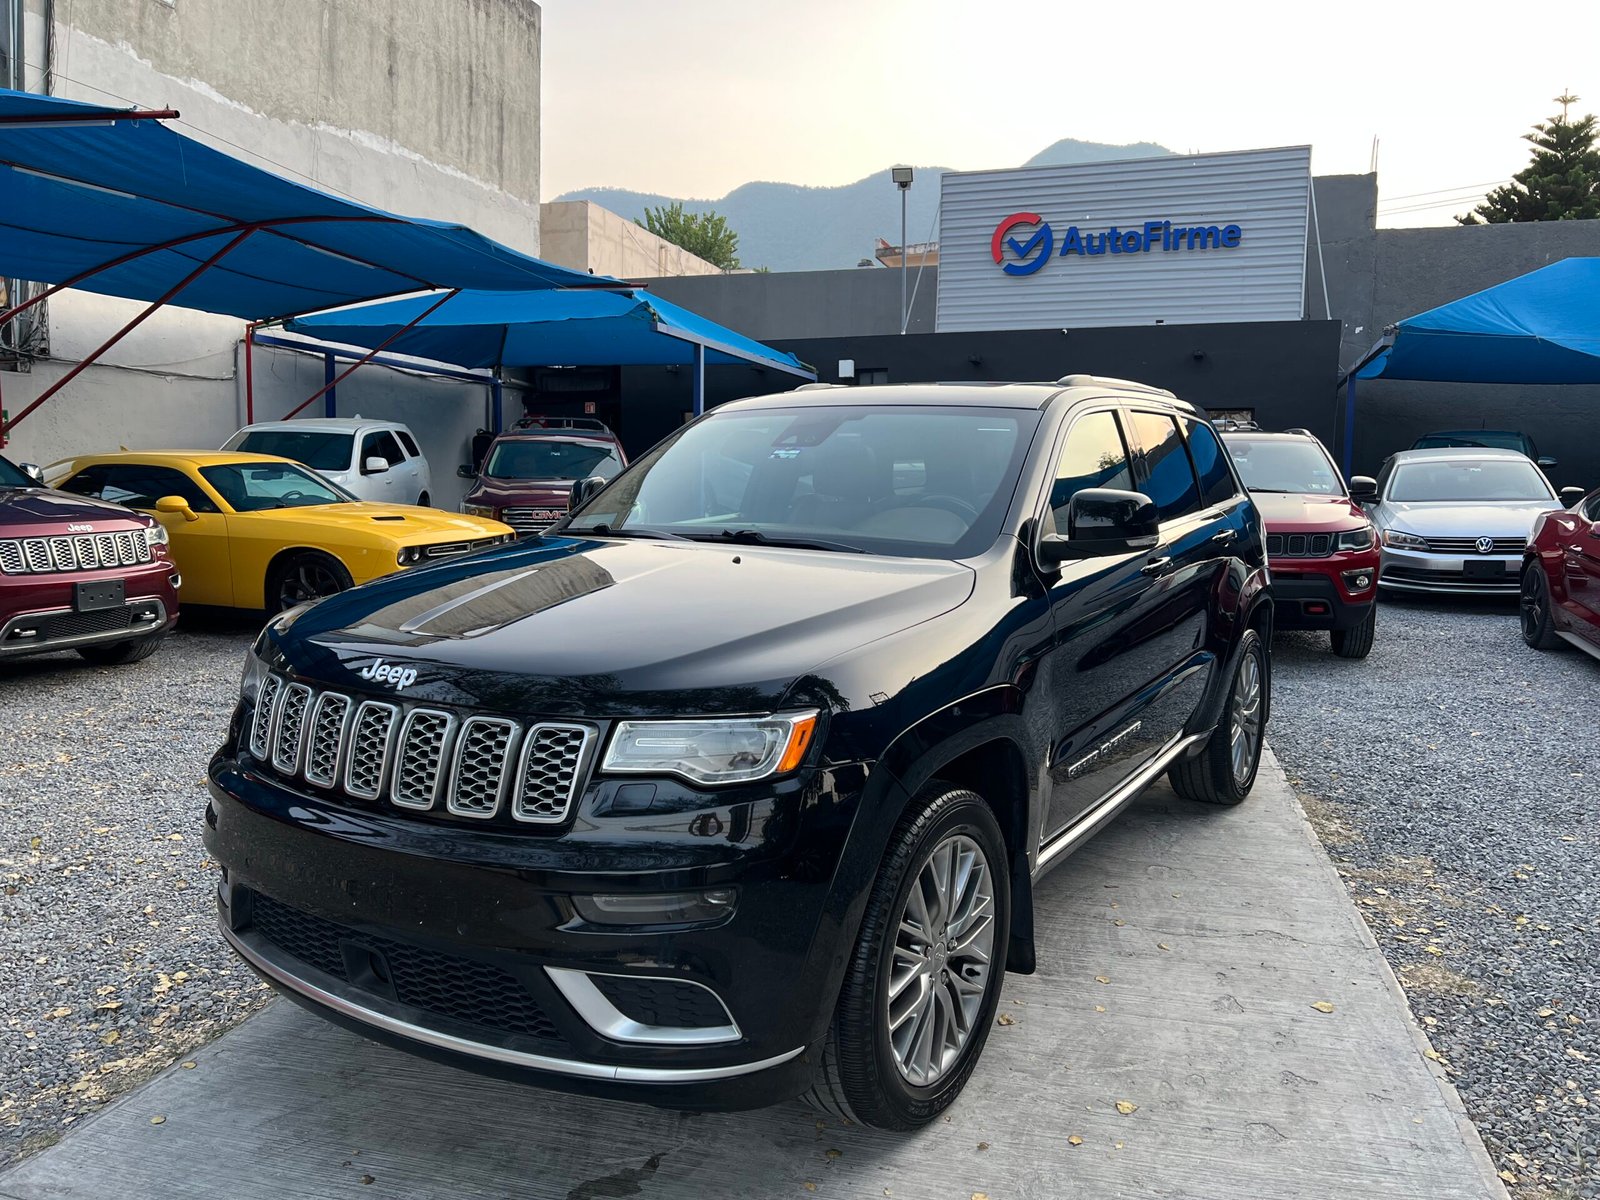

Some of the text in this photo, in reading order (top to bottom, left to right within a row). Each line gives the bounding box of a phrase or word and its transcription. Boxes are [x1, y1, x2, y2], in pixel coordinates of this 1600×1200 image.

[1059, 220, 1242, 257] AutoFirme
[67, 523, 93, 533] Jeep
[361, 658, 418, 691] Jeep
